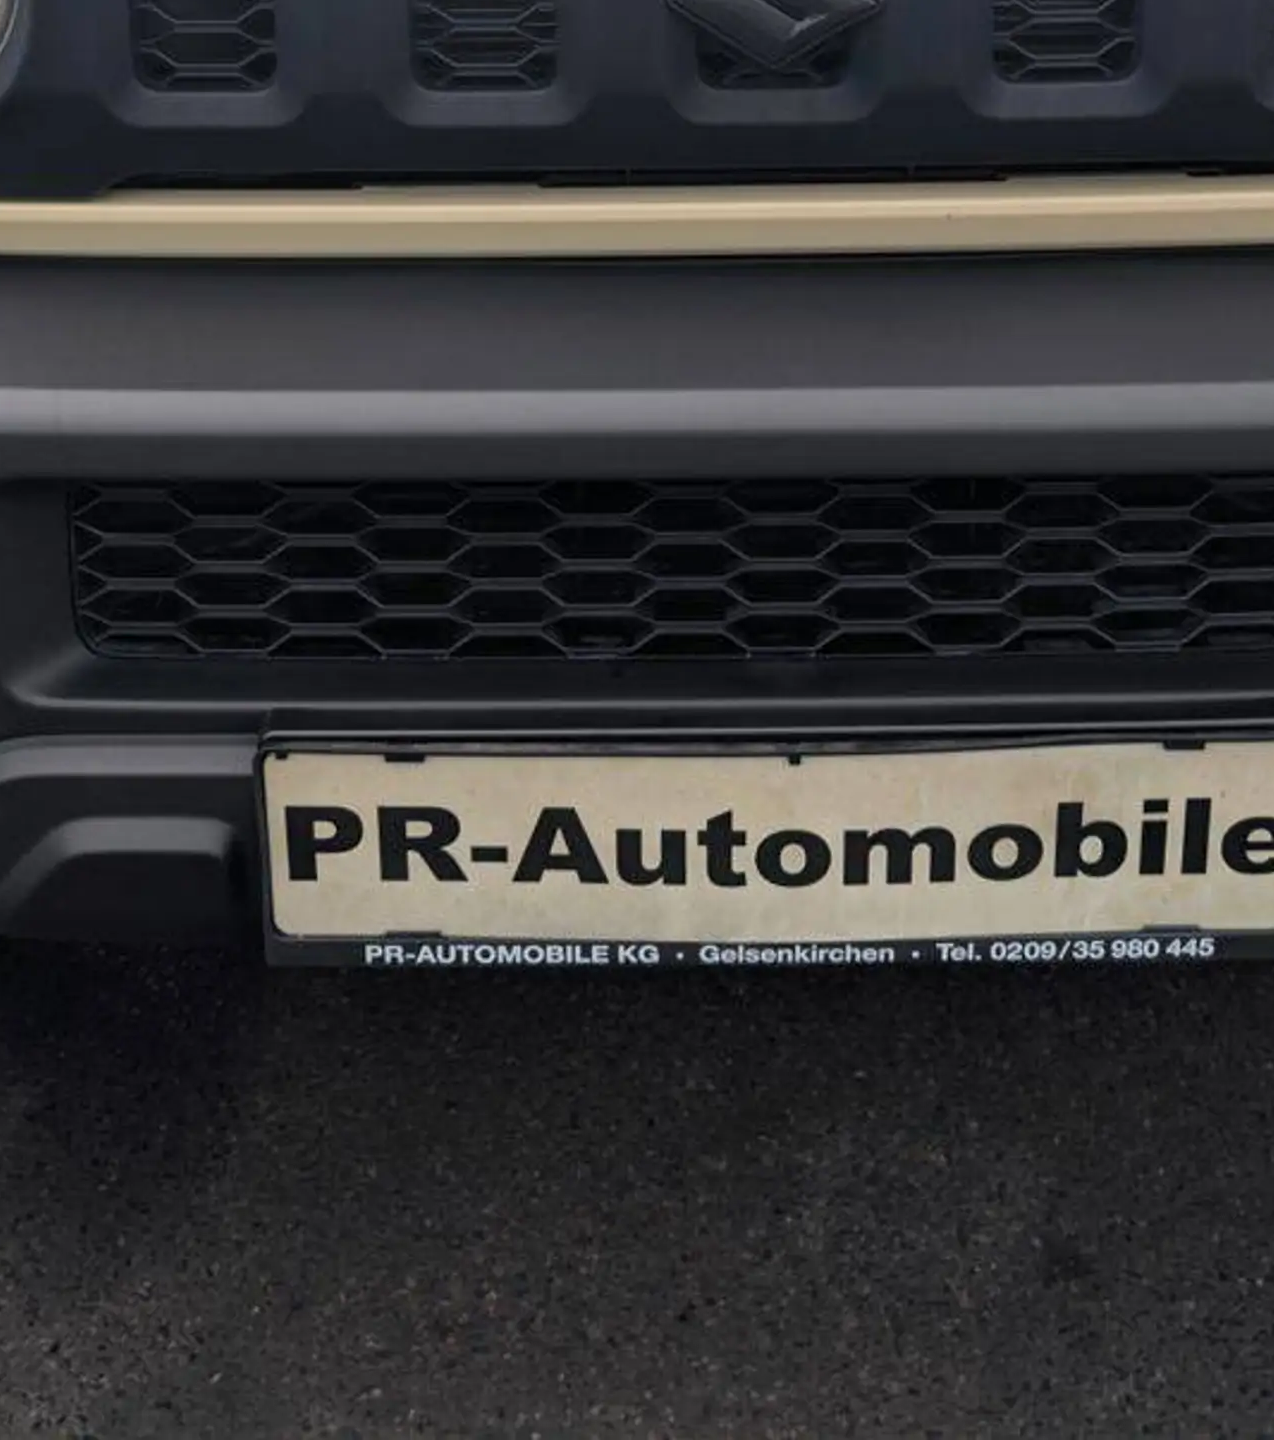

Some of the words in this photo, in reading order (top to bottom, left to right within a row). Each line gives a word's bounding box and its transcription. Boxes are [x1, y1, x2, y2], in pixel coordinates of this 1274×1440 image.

[364, 943, 610, 965] PR-AUTOMOBILE
[617, 944, 660, 965] KG
[698, 942, 895, 966] Gelsenkirchen
[935, 941, 982, 962] Tel.
[989, 939, 1105, 962] 0209/35
[1110, 938, 1159, 959] 980
[1165, 936, 1215, 958] 445
